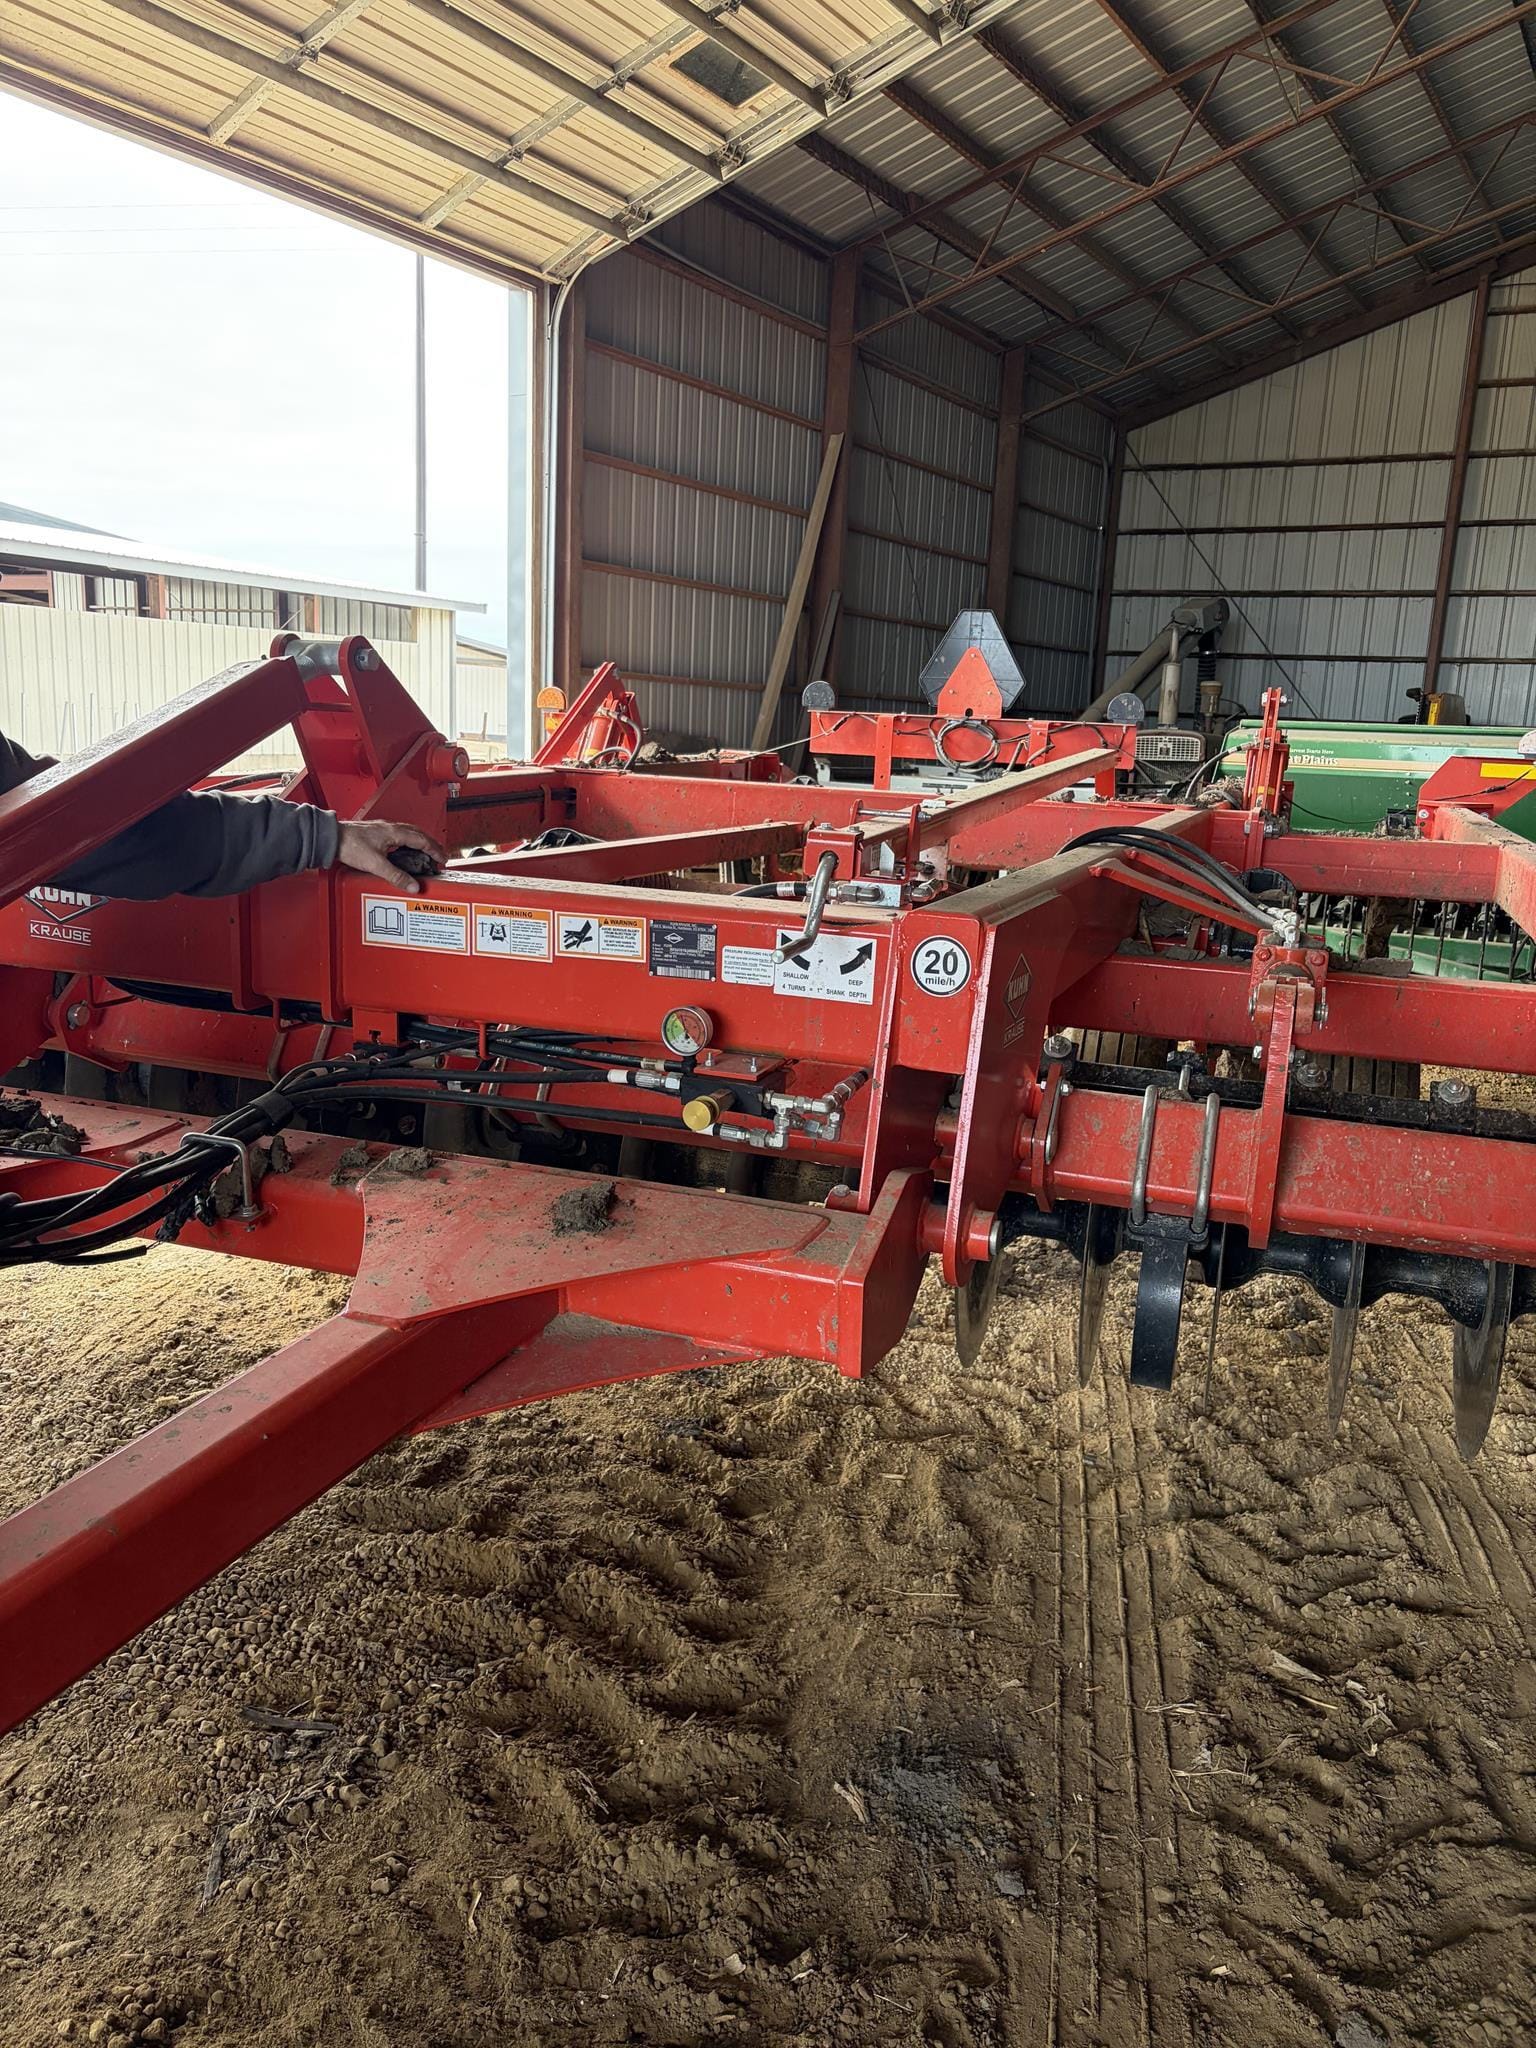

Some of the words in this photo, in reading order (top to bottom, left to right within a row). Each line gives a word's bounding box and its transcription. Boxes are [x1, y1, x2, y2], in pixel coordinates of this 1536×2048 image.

[1302, 754, 1338, 766] Plains
[422, 904, 459, 914] WARNING
[497, 909, 533, 918] WARNING
[610, 919, 638, 927] WARNING
[30, 923, 92, 943] KRAUSE
[924, 948, 959, 976] 20
[782, 971, 810, 980] SHALLOW
[925, 976, 956, 986] mile/h
[848, 979, 864, 987] DEEP
[1007, 973, 1030, 1004] KUHN
[788, 983, 806, 992] TURNS
[826, 988, 846, 996] SHANK
[848, 991, 867, 999] DEPTH
[1003, 1020, 1025, 1045] KRAUSE
